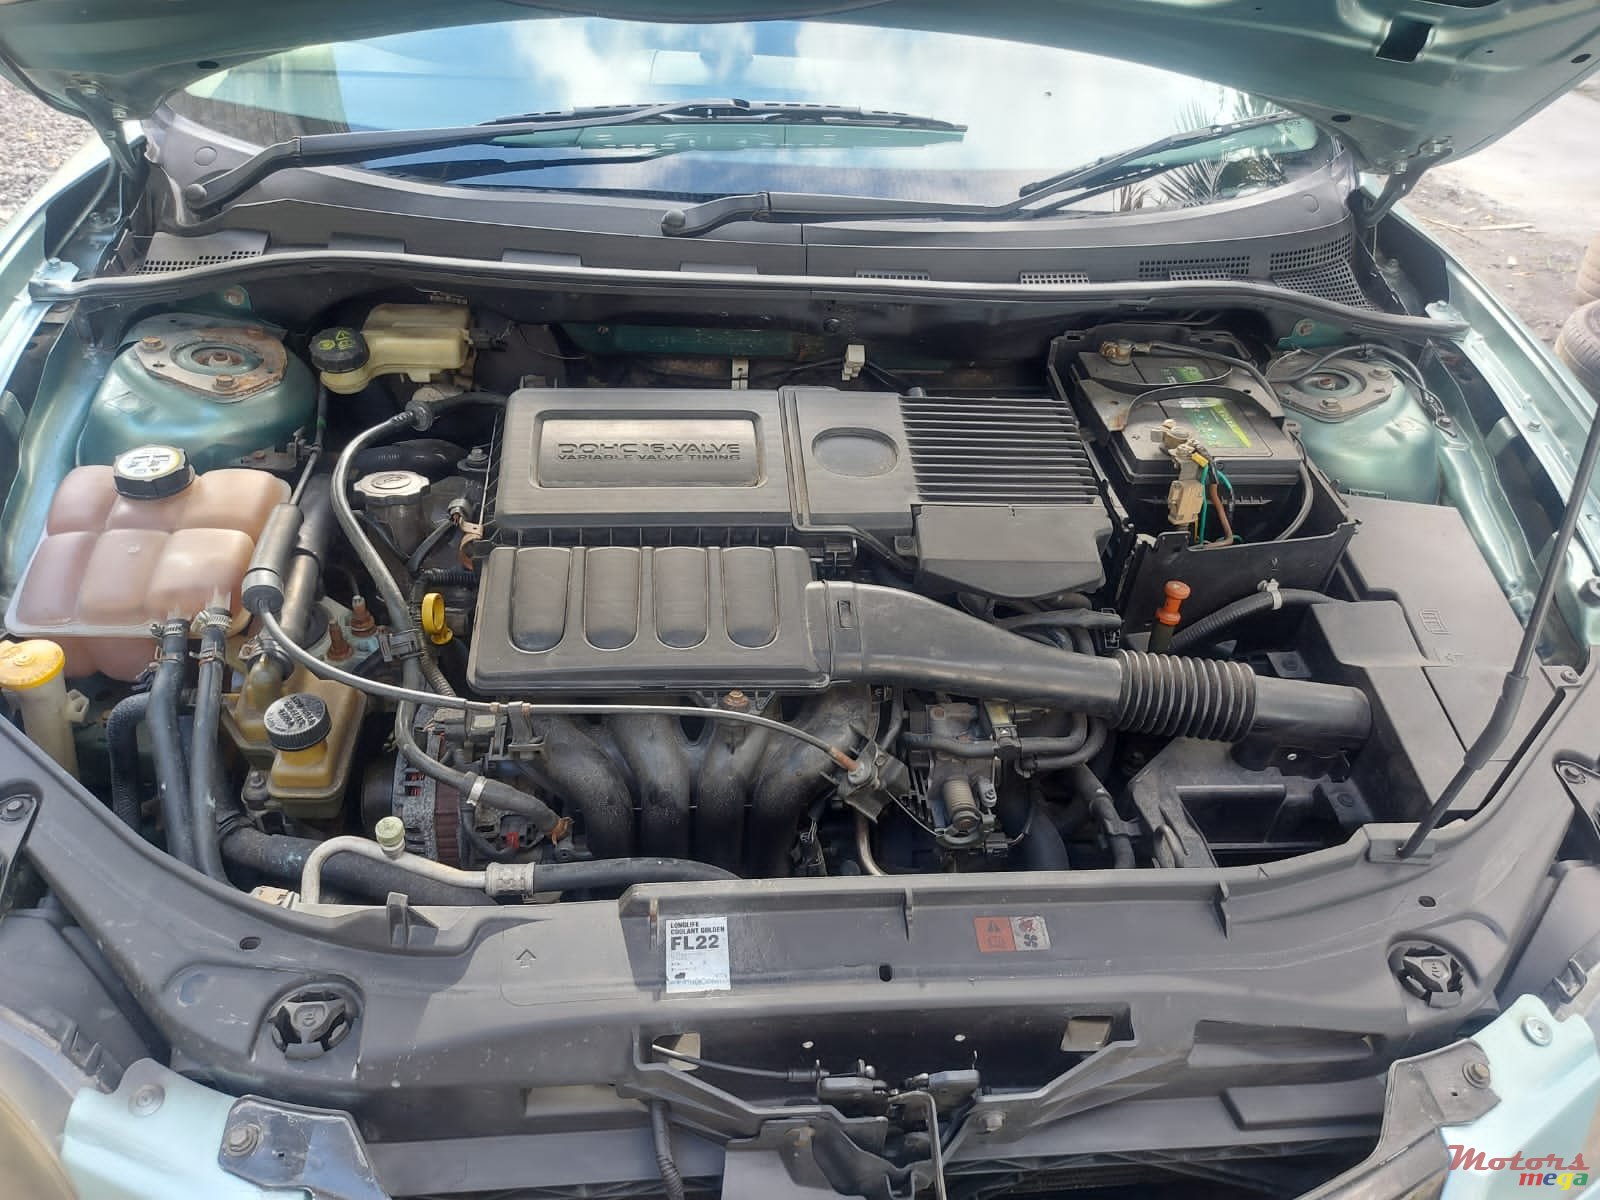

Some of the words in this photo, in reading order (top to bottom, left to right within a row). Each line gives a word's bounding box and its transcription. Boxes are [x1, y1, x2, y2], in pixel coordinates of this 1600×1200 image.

[558, 443, 639, 454] DOHC
[701, 926, 725, 934] GOLDEN
[670, 935, 720, 951] FL22
